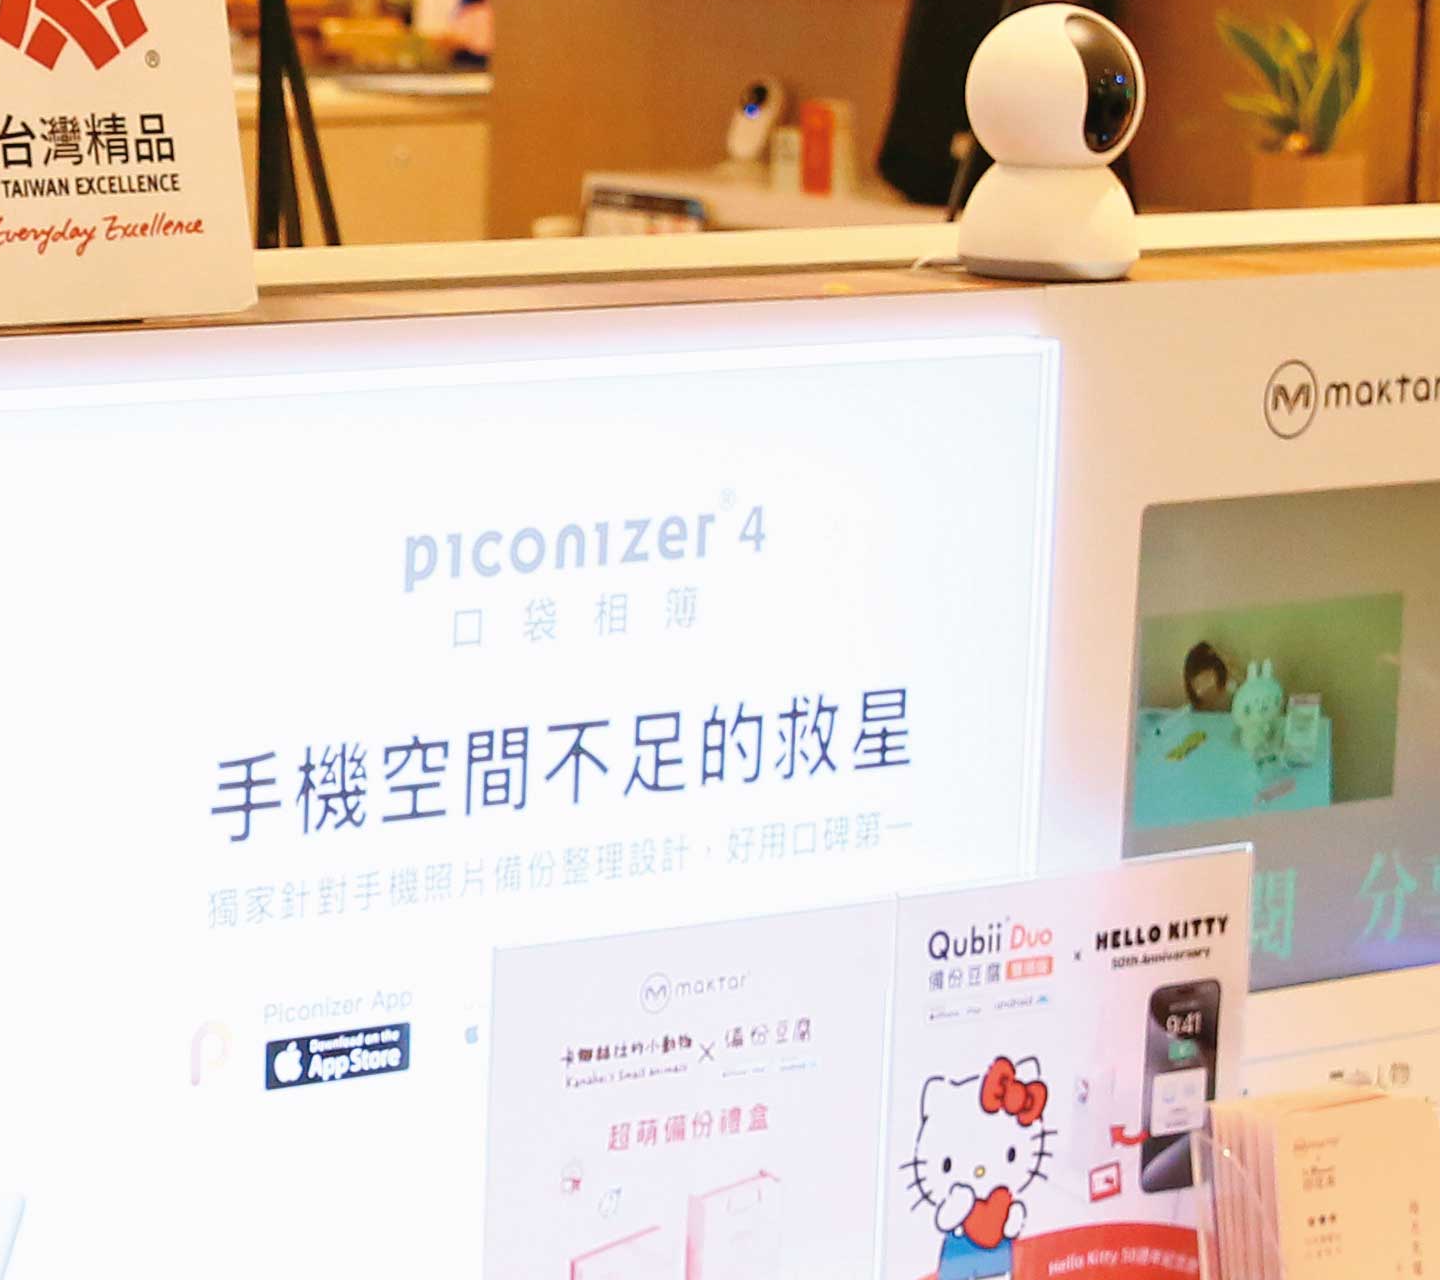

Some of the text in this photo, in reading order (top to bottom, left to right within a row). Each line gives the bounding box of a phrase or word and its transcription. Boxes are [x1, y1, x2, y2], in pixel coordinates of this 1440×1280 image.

[1, 172, 180, 198] TAIWAN EXCELLENCE
[102, 213, 204, 240] Excellence
[403, 504, 766, 592] piconizer 4
[452, 586, 698, 649] 口袋相簿
[210, 687, 912, 844] 手機空間不足的救星
[928, 923, 1053, 961] Qubii Duo
[1095, 916, 1228, 952] HELLO KITTY
[1140, 946, 1210, 965] Anniversary
[676, 973, 747, 996] maktar
[928, 962, 1002, 992] 備份豆腐
[264, 989, 413, 1024] Piconizer App
[309, 1034, 362, 1053] Download
[607, 1103, 769, 1152] 超萌備份禮盒
[1049, 1248, 1117, 1276] Hello Kitty
